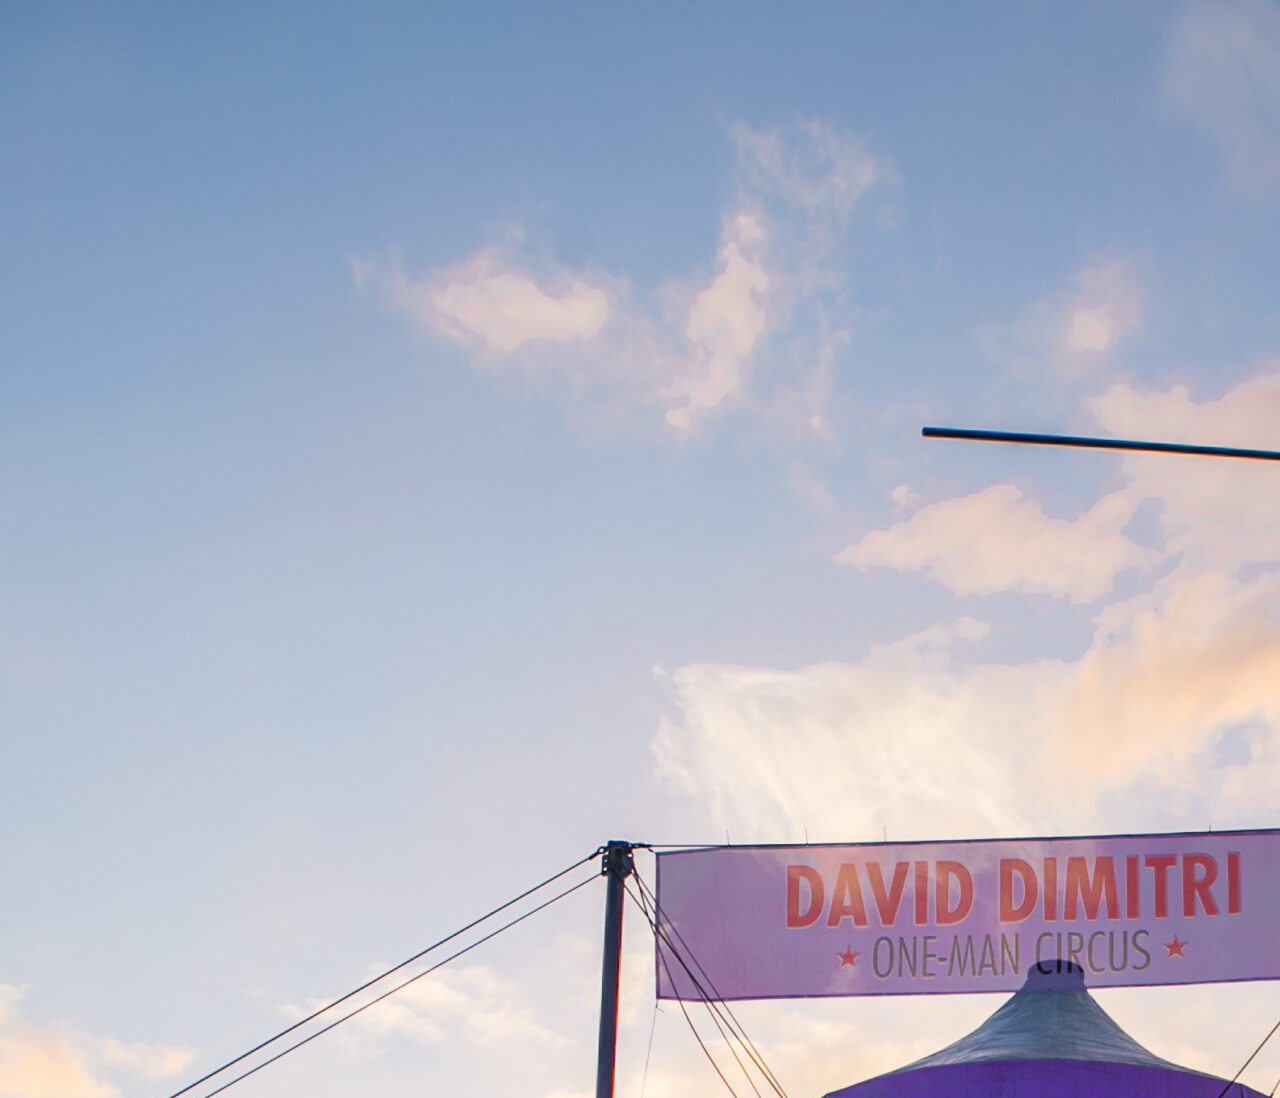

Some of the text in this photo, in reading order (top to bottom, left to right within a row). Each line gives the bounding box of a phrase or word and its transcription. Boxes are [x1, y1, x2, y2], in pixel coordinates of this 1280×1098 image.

[786, 852, 1240, 928] DAVID DIMITRI
[872, 929, 1151, 978] ONE-MAN CIRCUS
